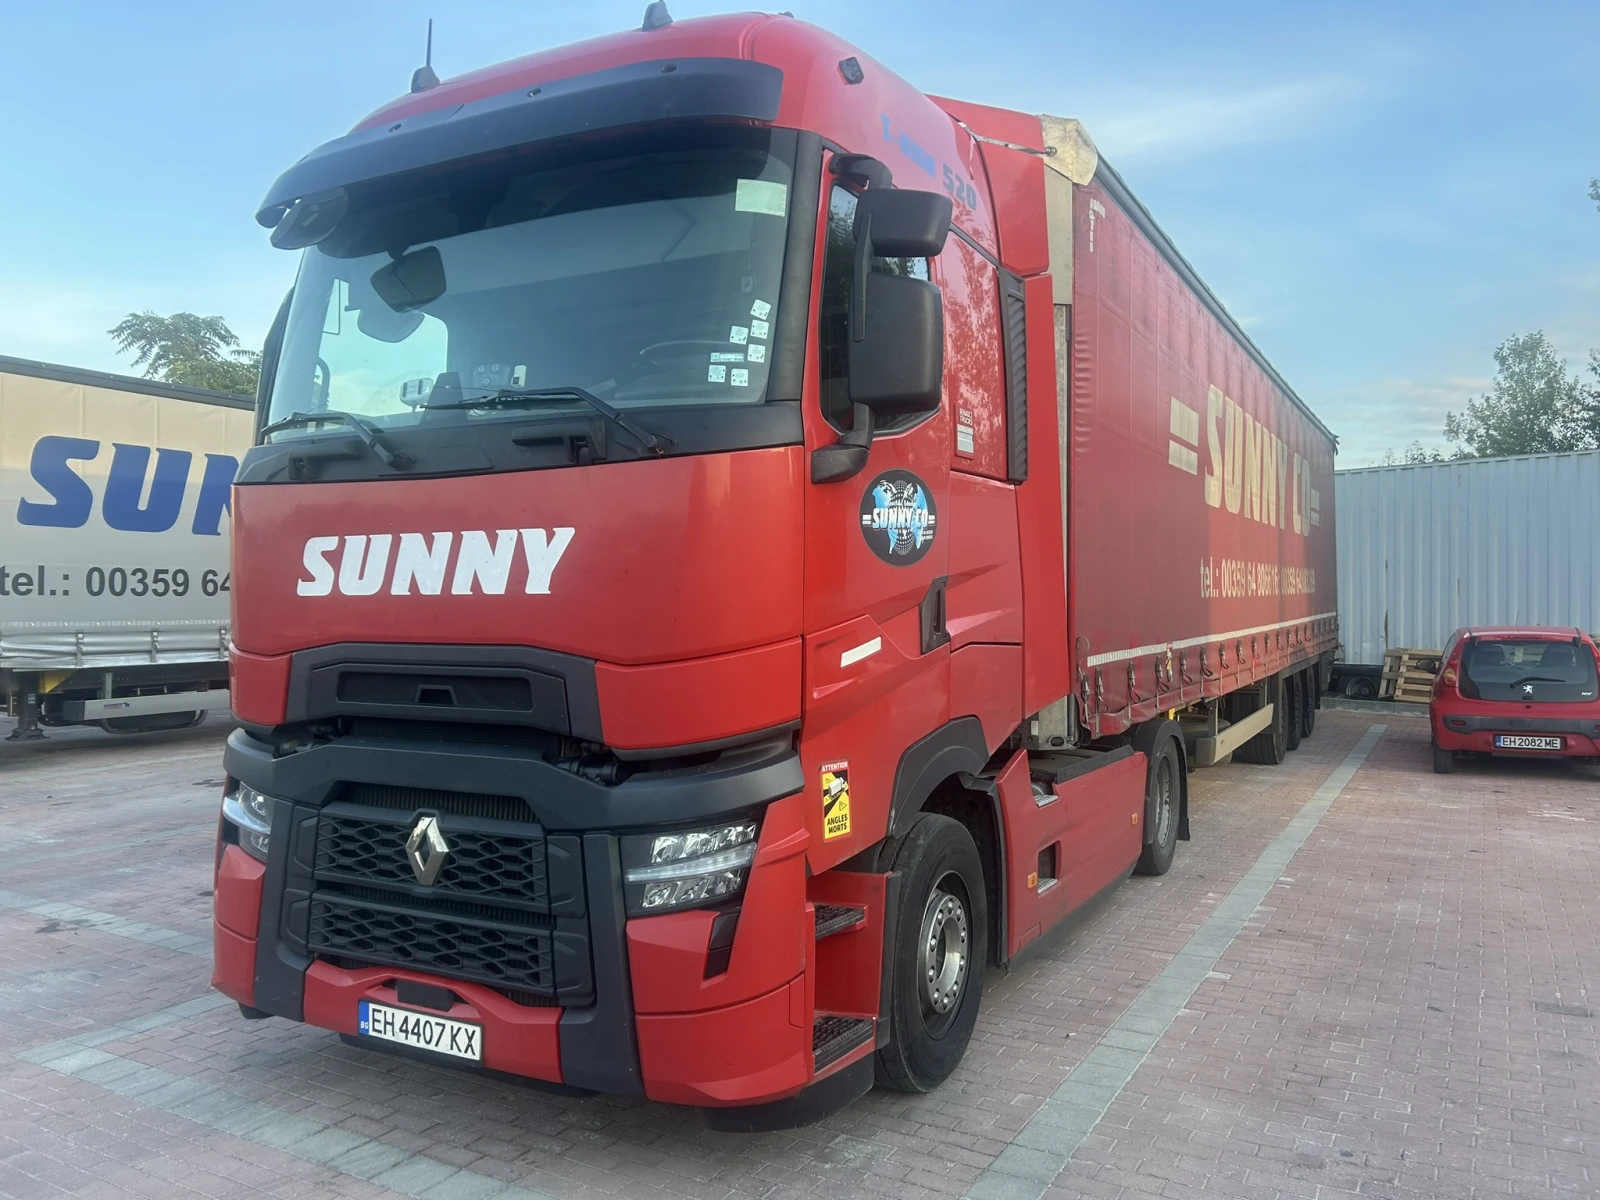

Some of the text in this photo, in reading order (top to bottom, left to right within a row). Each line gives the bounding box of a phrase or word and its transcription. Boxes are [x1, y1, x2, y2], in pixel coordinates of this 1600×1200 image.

[943, 163, 976, 211] 520
[1204, 384, 1311, 537] SUNNY CO
[872, 507, 928, 529] SUNNY CO
[297, 527, 575, 597] SUNNY
[0, 565, 70, 596] tel.:
[86, 566, 190, 597] 00359
[1222, 558, 1246, 598] 00359
[1502, 737, 1516, 747] EH
[1518, 738, 1543, 748] 2082
[821, 761, 848, 772] ATTENTION
[827, 814, 848, 826] ANGLES
[828, 822, 847, 834] MORTS
[360, 1021, 369, 1029] BG
[372, 1008, 476, 1056] EH 4407 KX
